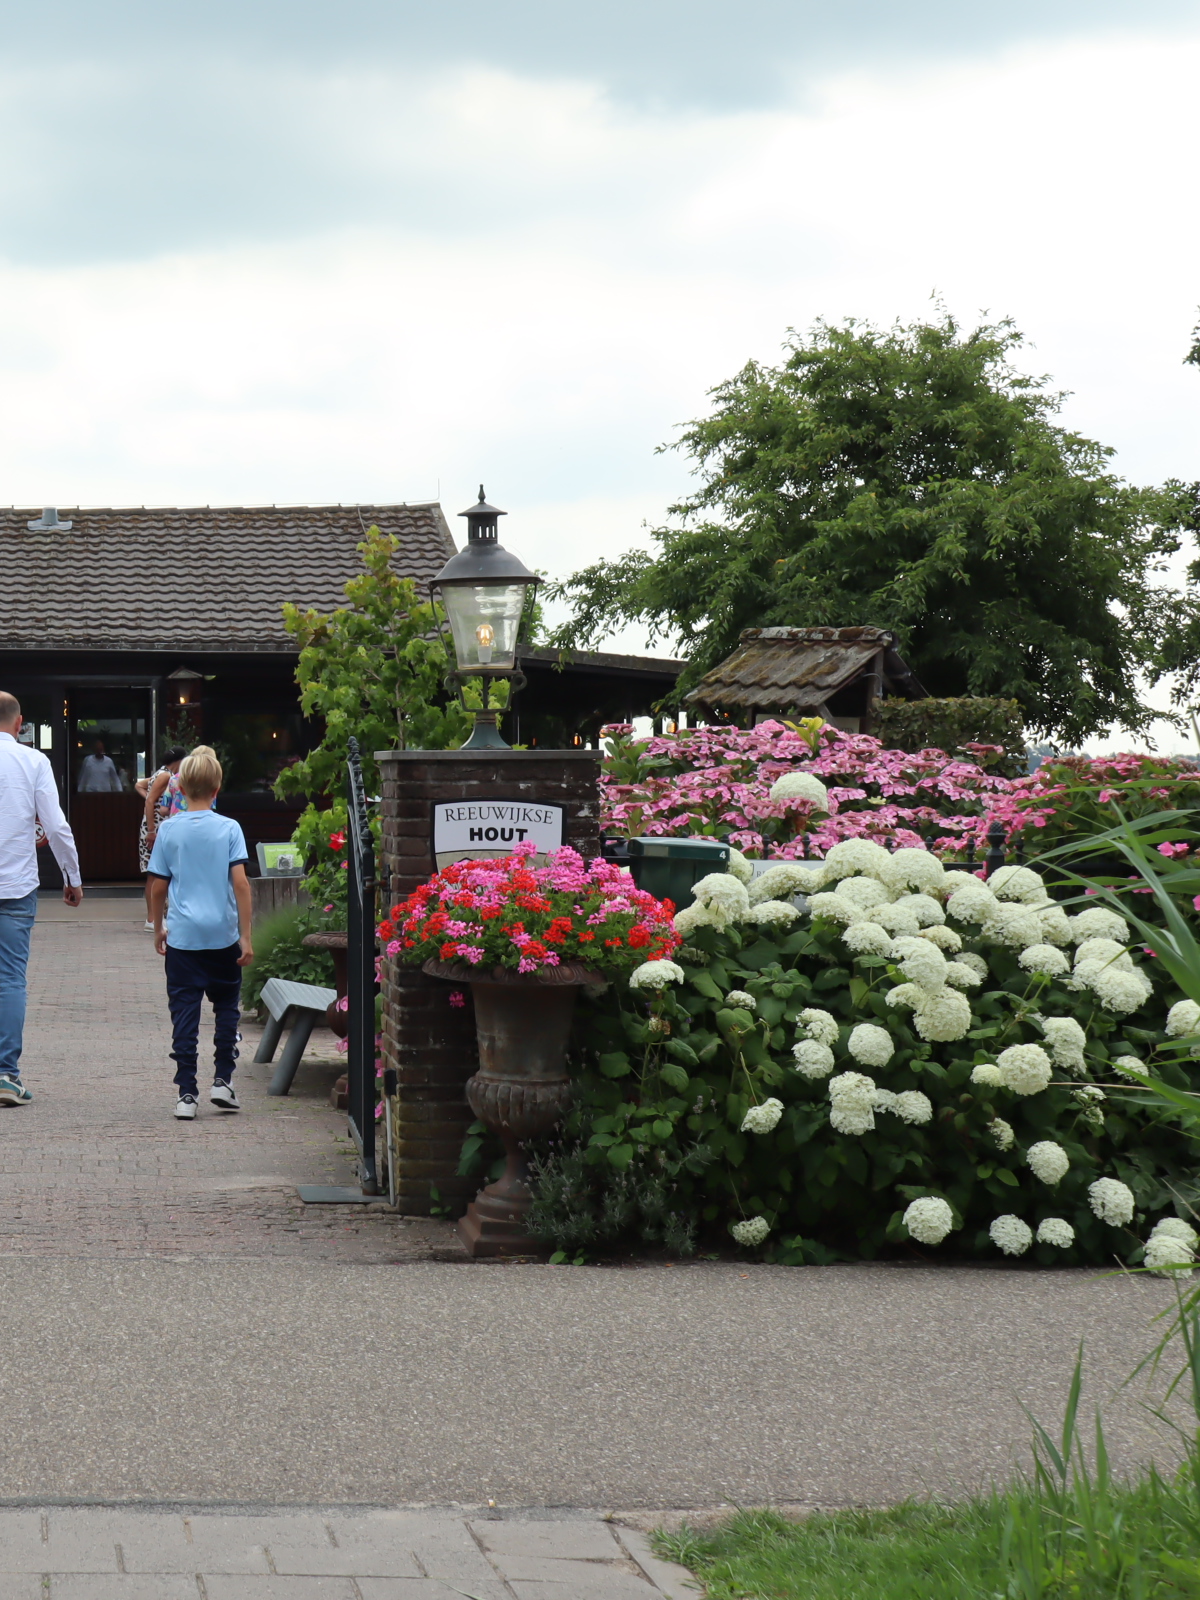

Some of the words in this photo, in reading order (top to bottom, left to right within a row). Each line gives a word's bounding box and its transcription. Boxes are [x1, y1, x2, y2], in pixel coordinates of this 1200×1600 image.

[444, 806, 553, 825] REEUWIJKSE
[469, 826, 529, 842] HOUT
[719, 850, 727, 860] 4
